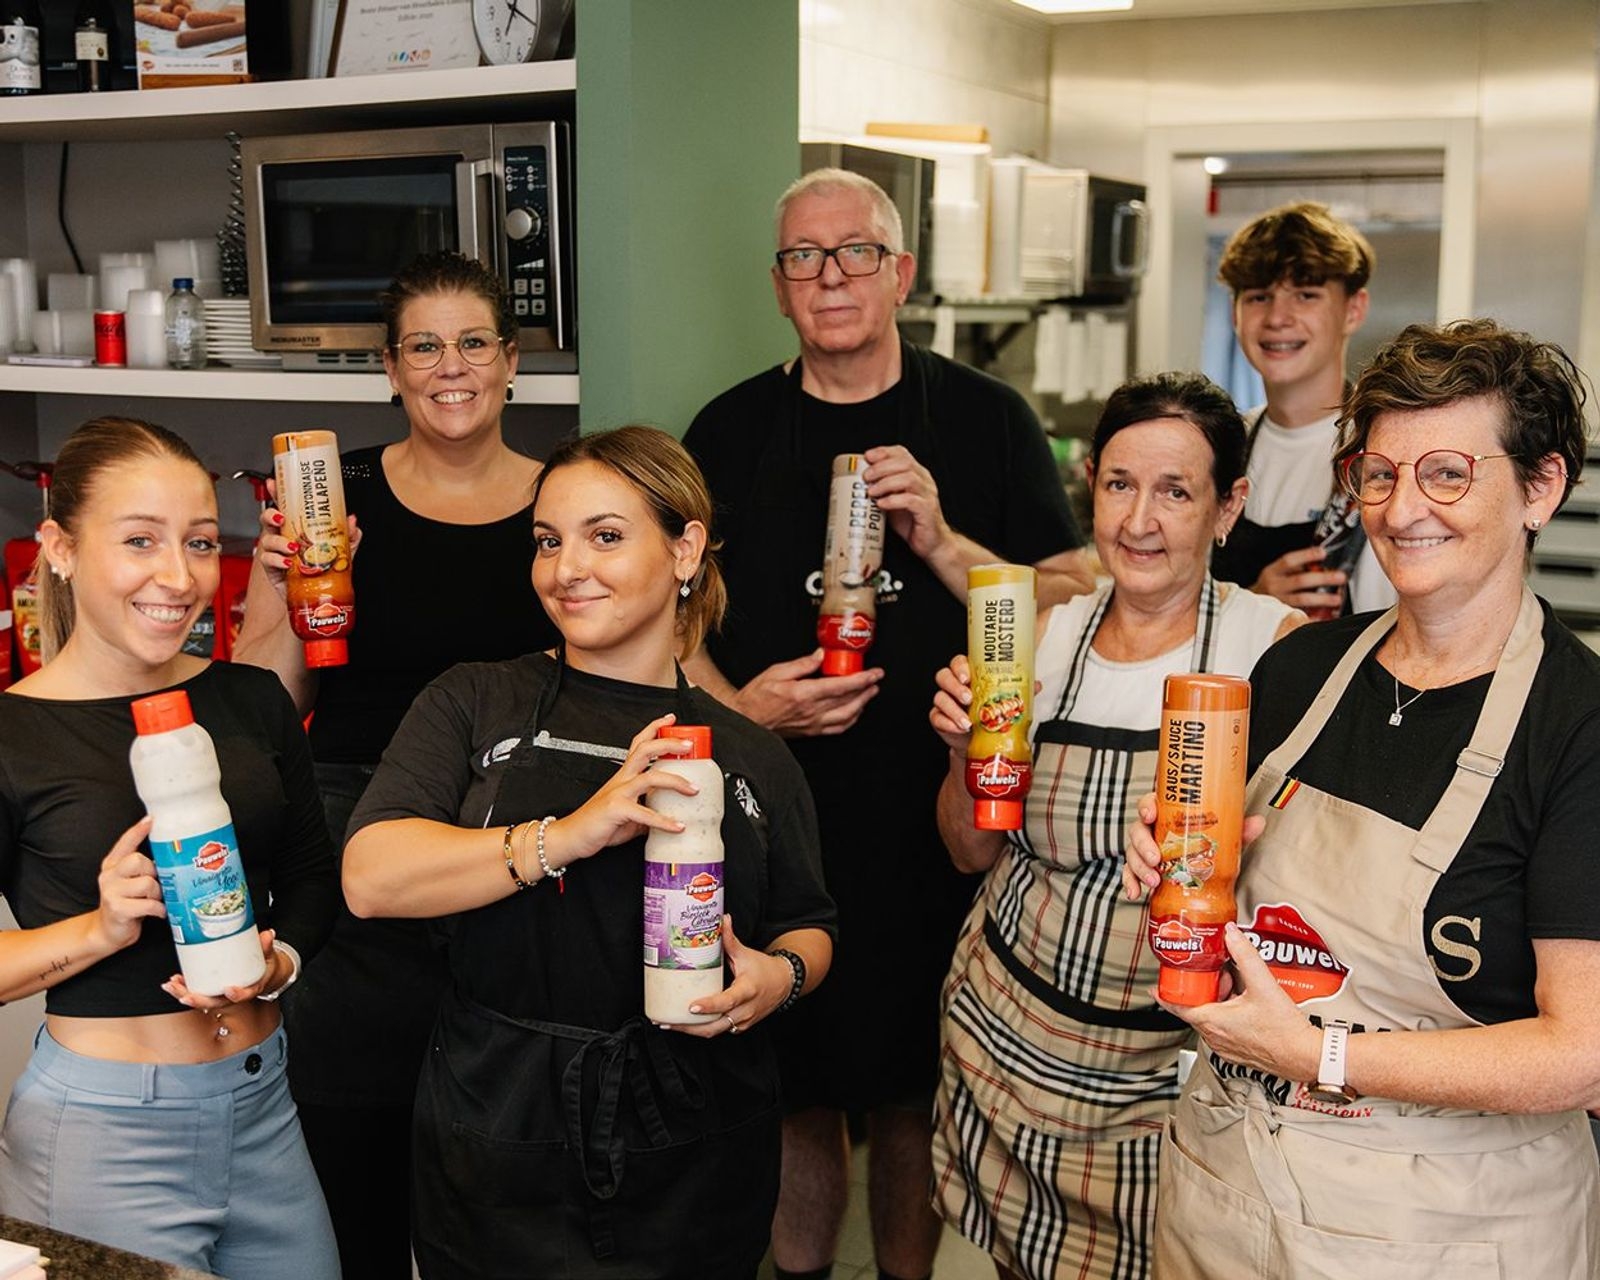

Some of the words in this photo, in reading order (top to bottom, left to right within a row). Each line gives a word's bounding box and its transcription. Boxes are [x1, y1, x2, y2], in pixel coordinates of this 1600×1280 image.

[300, 460, 316, 520] MAYONNAISE
[310, 614, 345, 627] Pauwels
[984, 599, 998, 662] MOUTARDE
[998, 598, 1015, 662] MOSTERD
[979, 773, 1017, 785] Pauwels
[1165, 718, 1183, 803] SAUS/SAUCE
[1179, 719, 1206, 805] MARTINO
[687, 883, 718, 894] Pauwels
[1155, 937, 1198, 950] Pauwels
[1428, 915, 1482, 982] S
